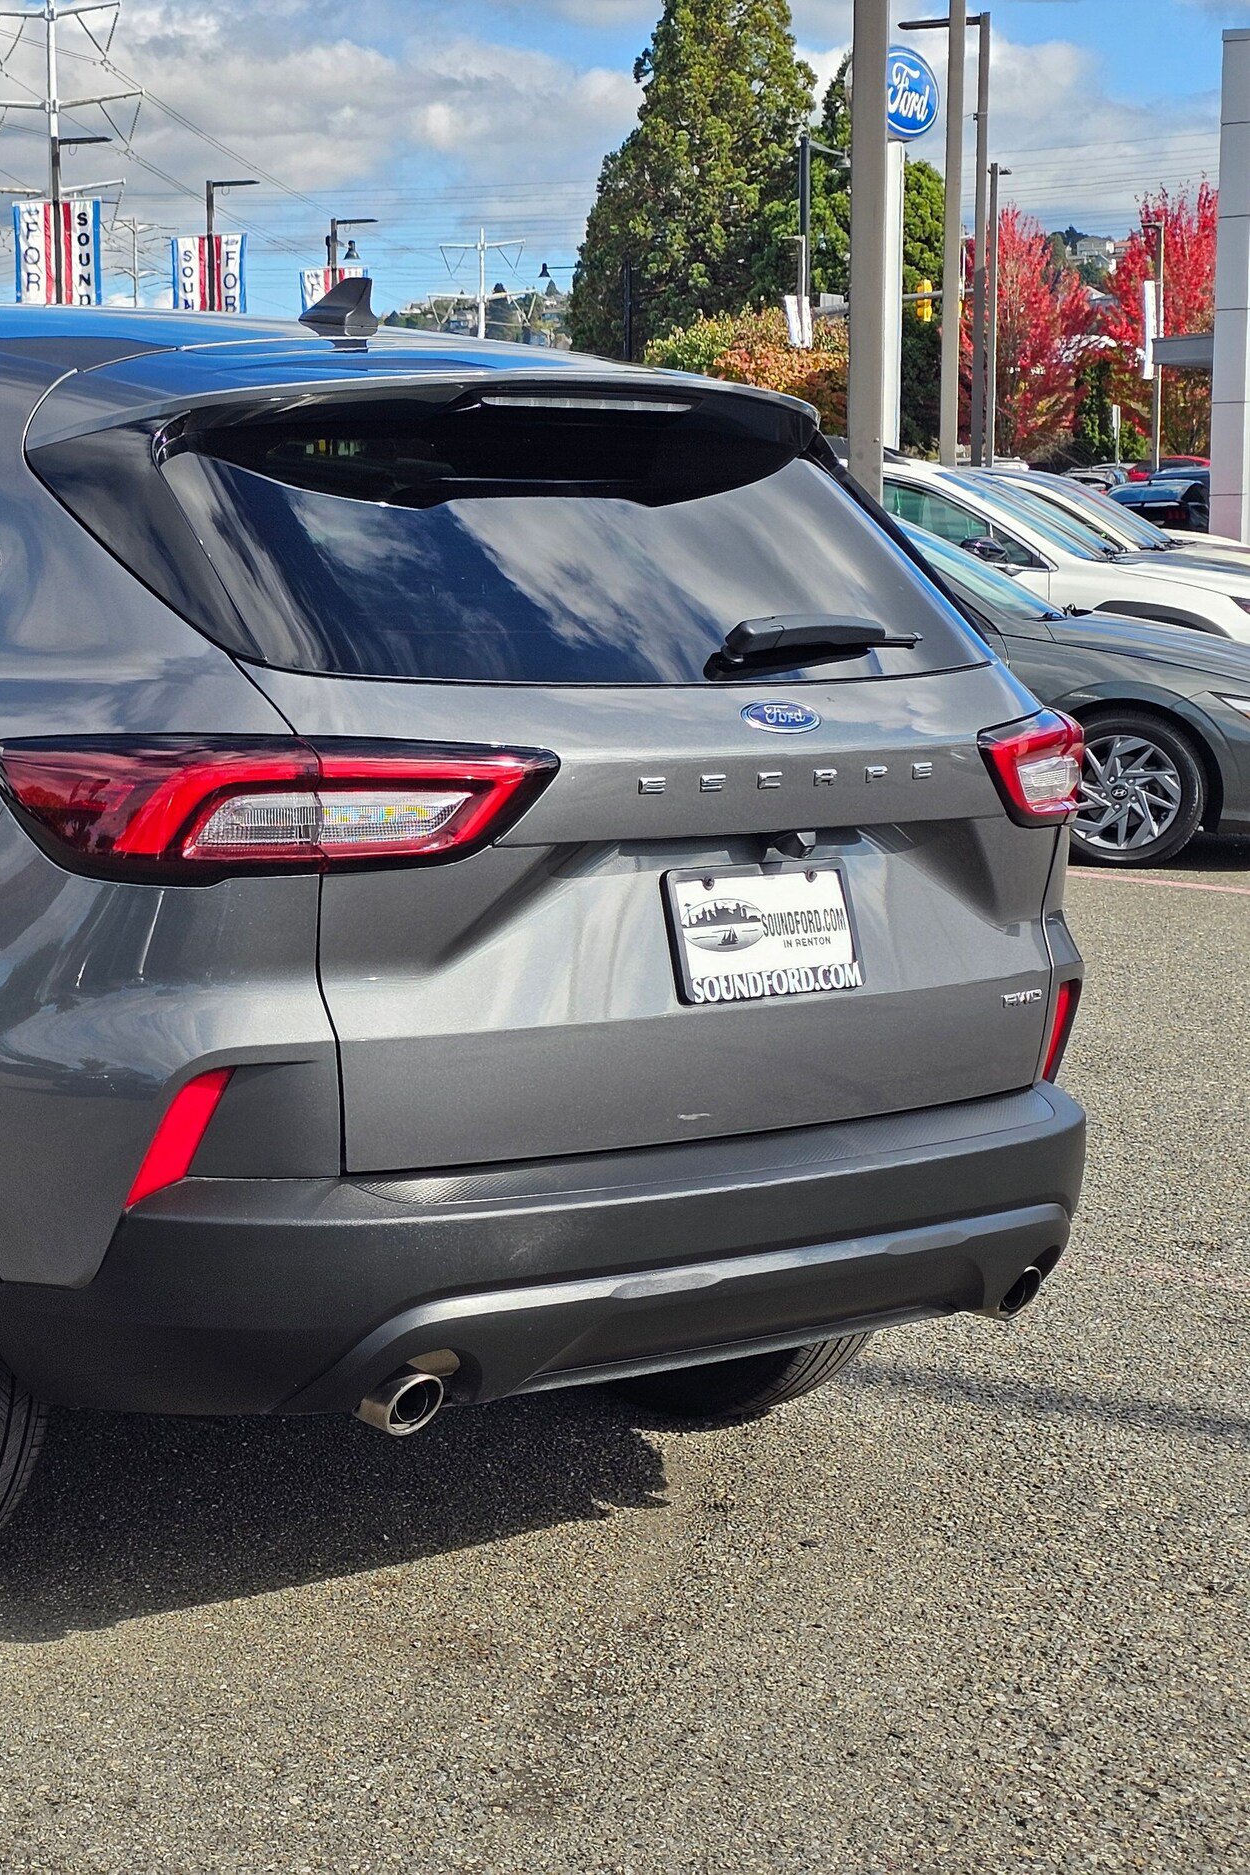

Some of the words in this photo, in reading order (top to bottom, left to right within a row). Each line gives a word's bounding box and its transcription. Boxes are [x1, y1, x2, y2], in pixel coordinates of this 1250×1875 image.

[888, 62, 930, 122] Ford
[23, 221, 41, 292] FOR
[182, 250, 194, 311] SOUN
[223, 250, 237, 312] FOR
[763, 704, 806, 724] Ford
[638, 761, 933, 795] ESCAPE
[761, 907, 847, 937] SOUNDFORD.COM
[783, 938, 793, 949] IN
[795, 936, 832, 948] RENTON
[692, 960, 863, 1004] SOUNDFORD.COM
